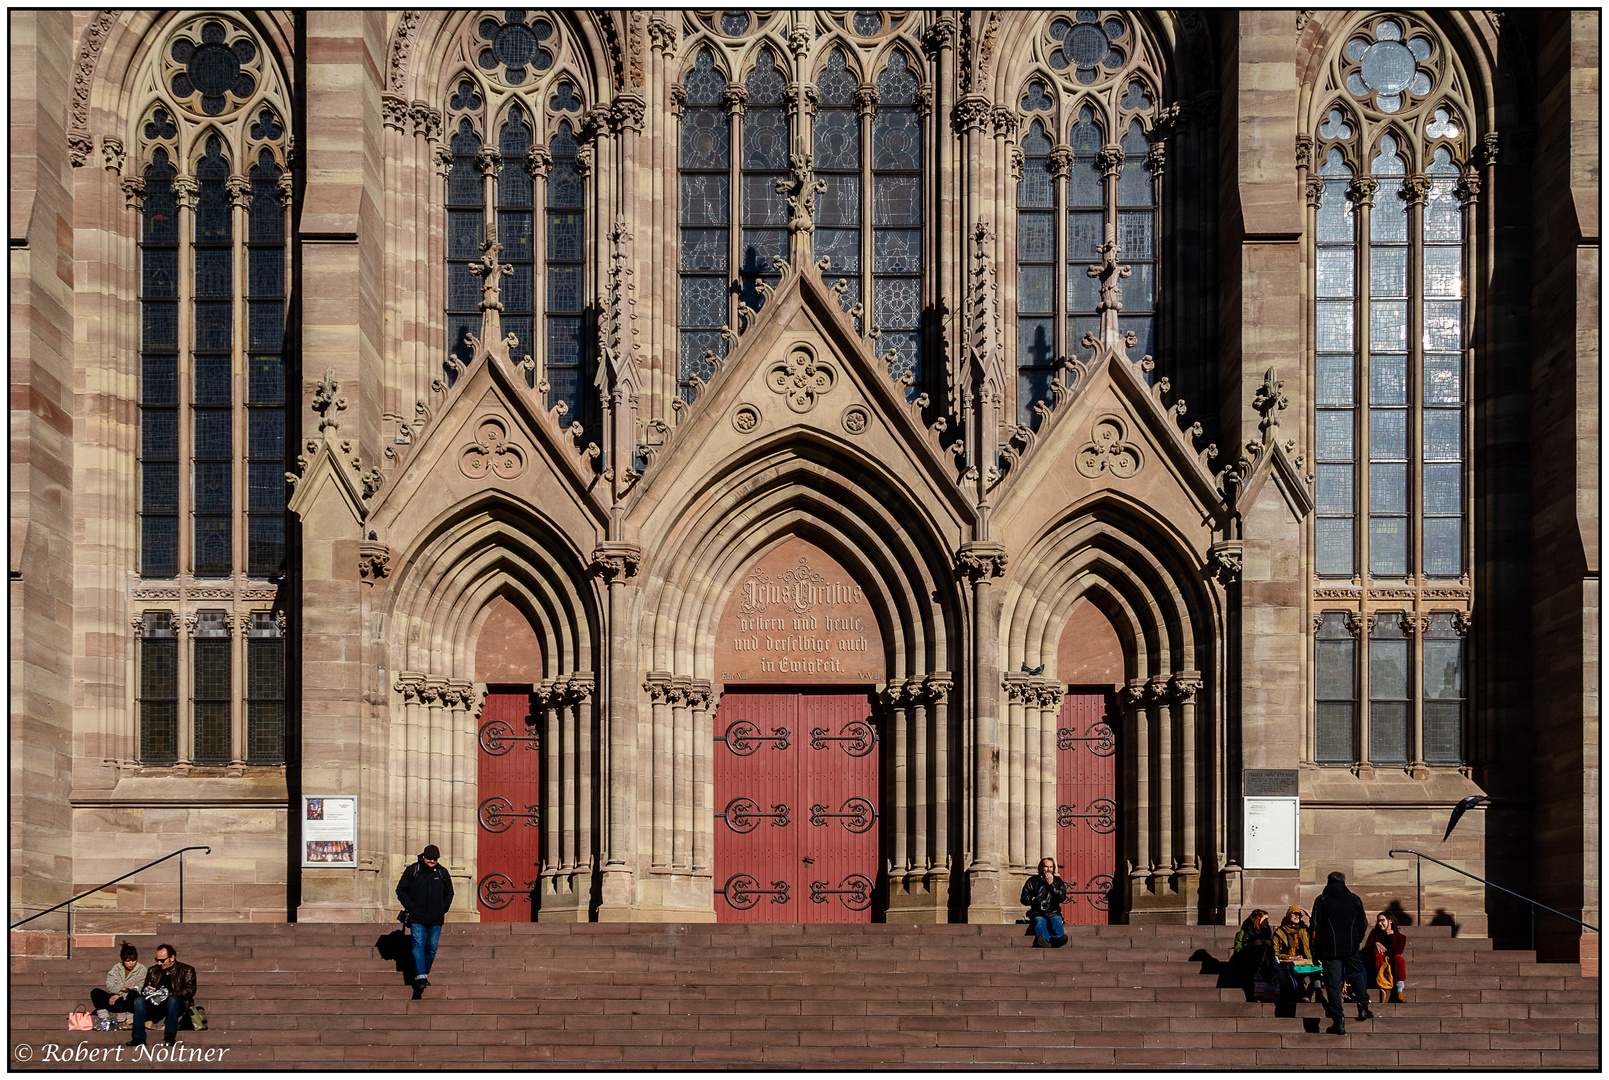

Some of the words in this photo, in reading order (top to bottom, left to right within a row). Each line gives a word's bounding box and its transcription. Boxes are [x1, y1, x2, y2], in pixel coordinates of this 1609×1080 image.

[740, 616, 785, 634] gestern
[793, 616, 817, 632] und
[734, 636, 759, 651] und
[766, 635, 831, 654] derselbige
[838, 636, 868, 654] auch
[761, 657, 775, 673] in
[778, 656, 845, 675] Ewigkeit.
